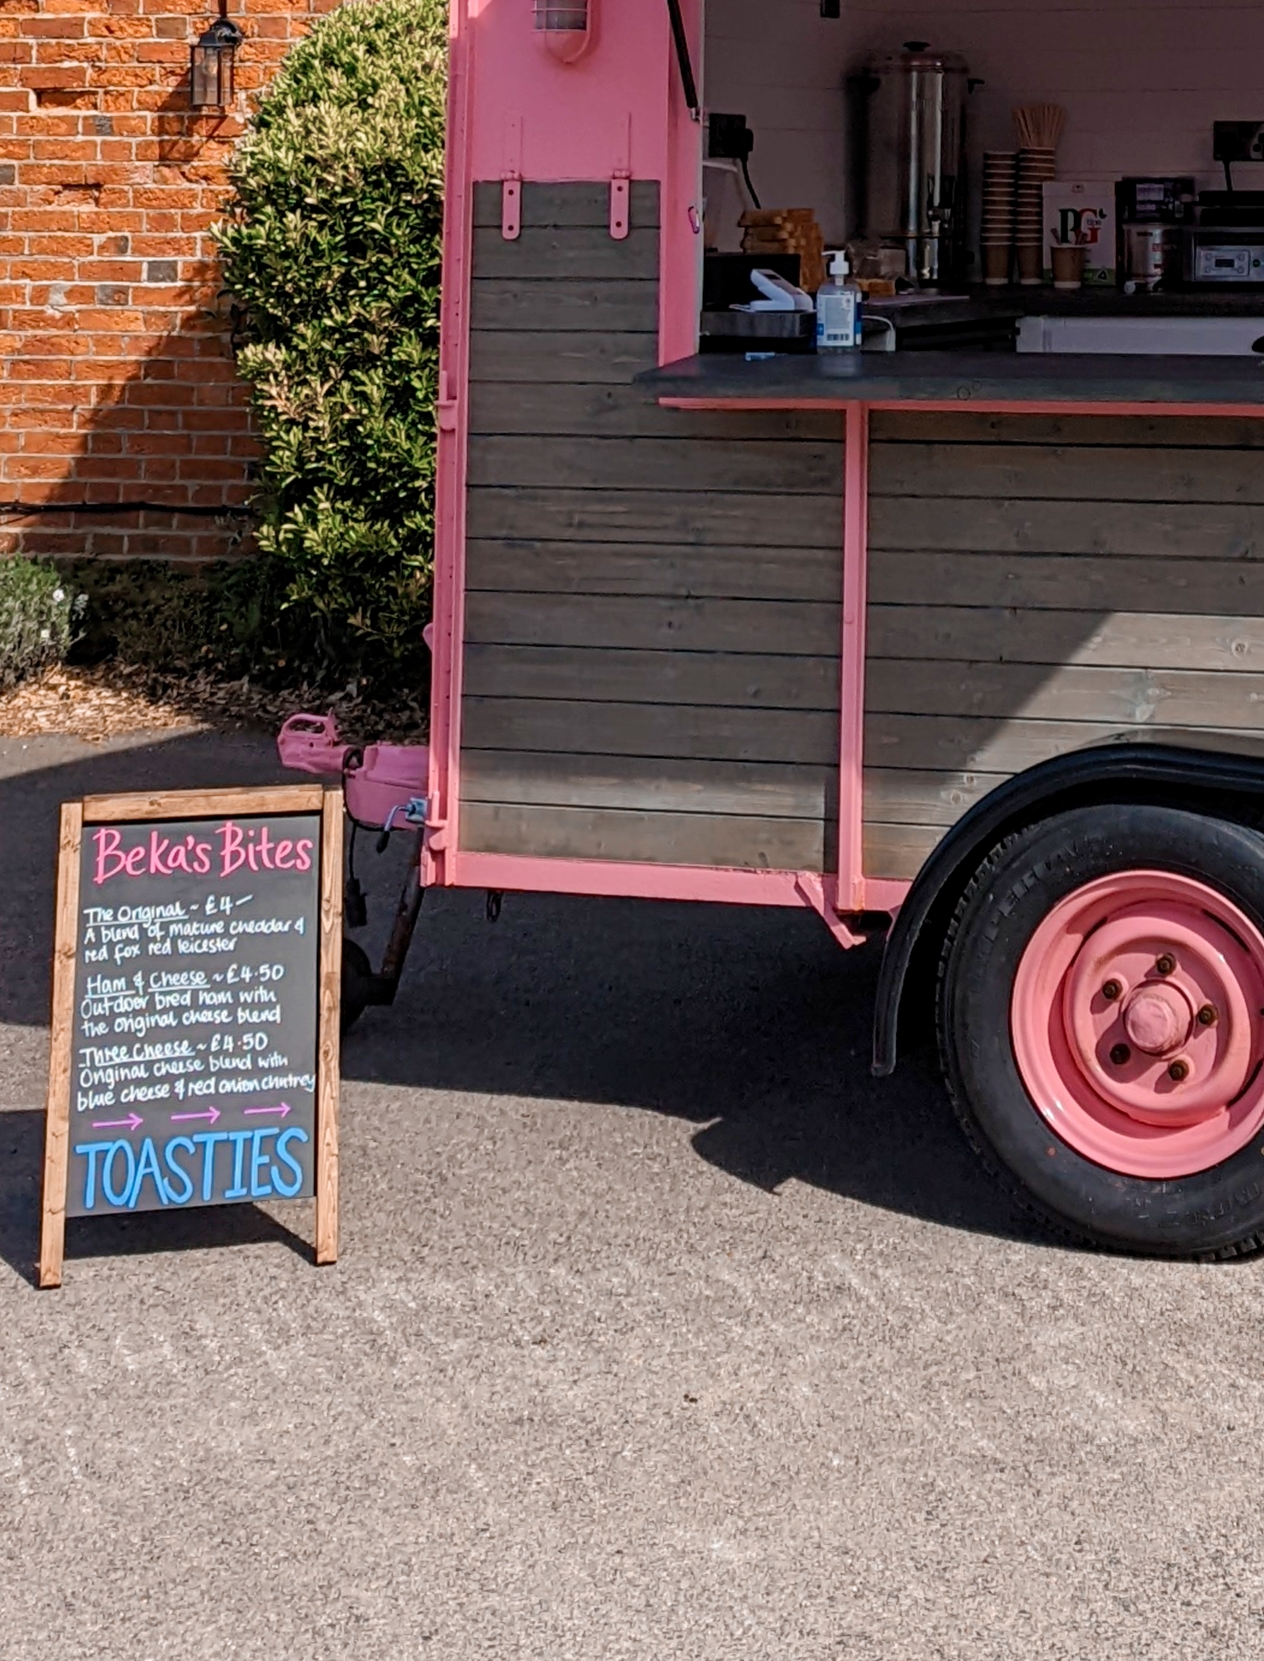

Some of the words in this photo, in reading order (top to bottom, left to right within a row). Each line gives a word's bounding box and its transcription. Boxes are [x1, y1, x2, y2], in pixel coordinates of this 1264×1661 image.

[1058, 208, 1101, 244] PG
[92, 828, 212, 884] Beka's
[215, 821, 313, 877] Bites
[83, 907, 114, 924] The
[117, 901, 186, 927] Original
[84, 928, 96, 945] A
[101, 925, 140, 944] blend
[147, 923, 165, 942] of
[169, 921, 225, 937] mature
[229, 917, 292, 936] cheddar
[84, 947, 108, 964] red
[114, 944, 140, 965] fox
[148, 937, 172, 956] red
[178, 936, 238, 954] leicester
[86, 973, 127, 993] Ham
[149, 969, 207, 988] Cheese
[80, 995, 150, 1020] Outdoor
[155, 991, 191, 1010] bred
[199, 990, 234, 1005] ham
[239, 987, 277, 1003] with
[80, 1020, 109, 1038] the
[114, 1013, 178, 1037] original
[182, 1008, 233, 1026] cheese
[237, 1005, 281, 1025] blend
[79, 1046, 129, 1066] Three
[132, 1039, 193, 1059] Cheese
[79, 1063, 150, 1089] Original
[153, 1058, 205, 1077] cheese
[209, 1054, 252, 1072] blend
[258, 1052, 288, 1067] with
[77, 1091, 116, 1112] blue
[120, 1084, 170, 1104] cheese
[187, 1076, 216, 1097] red
[218, 1077, 260, 1093] onion
[261, 1073, 316, 1092] chutney
[75, 1127, 309, 1210] TOASTIES
